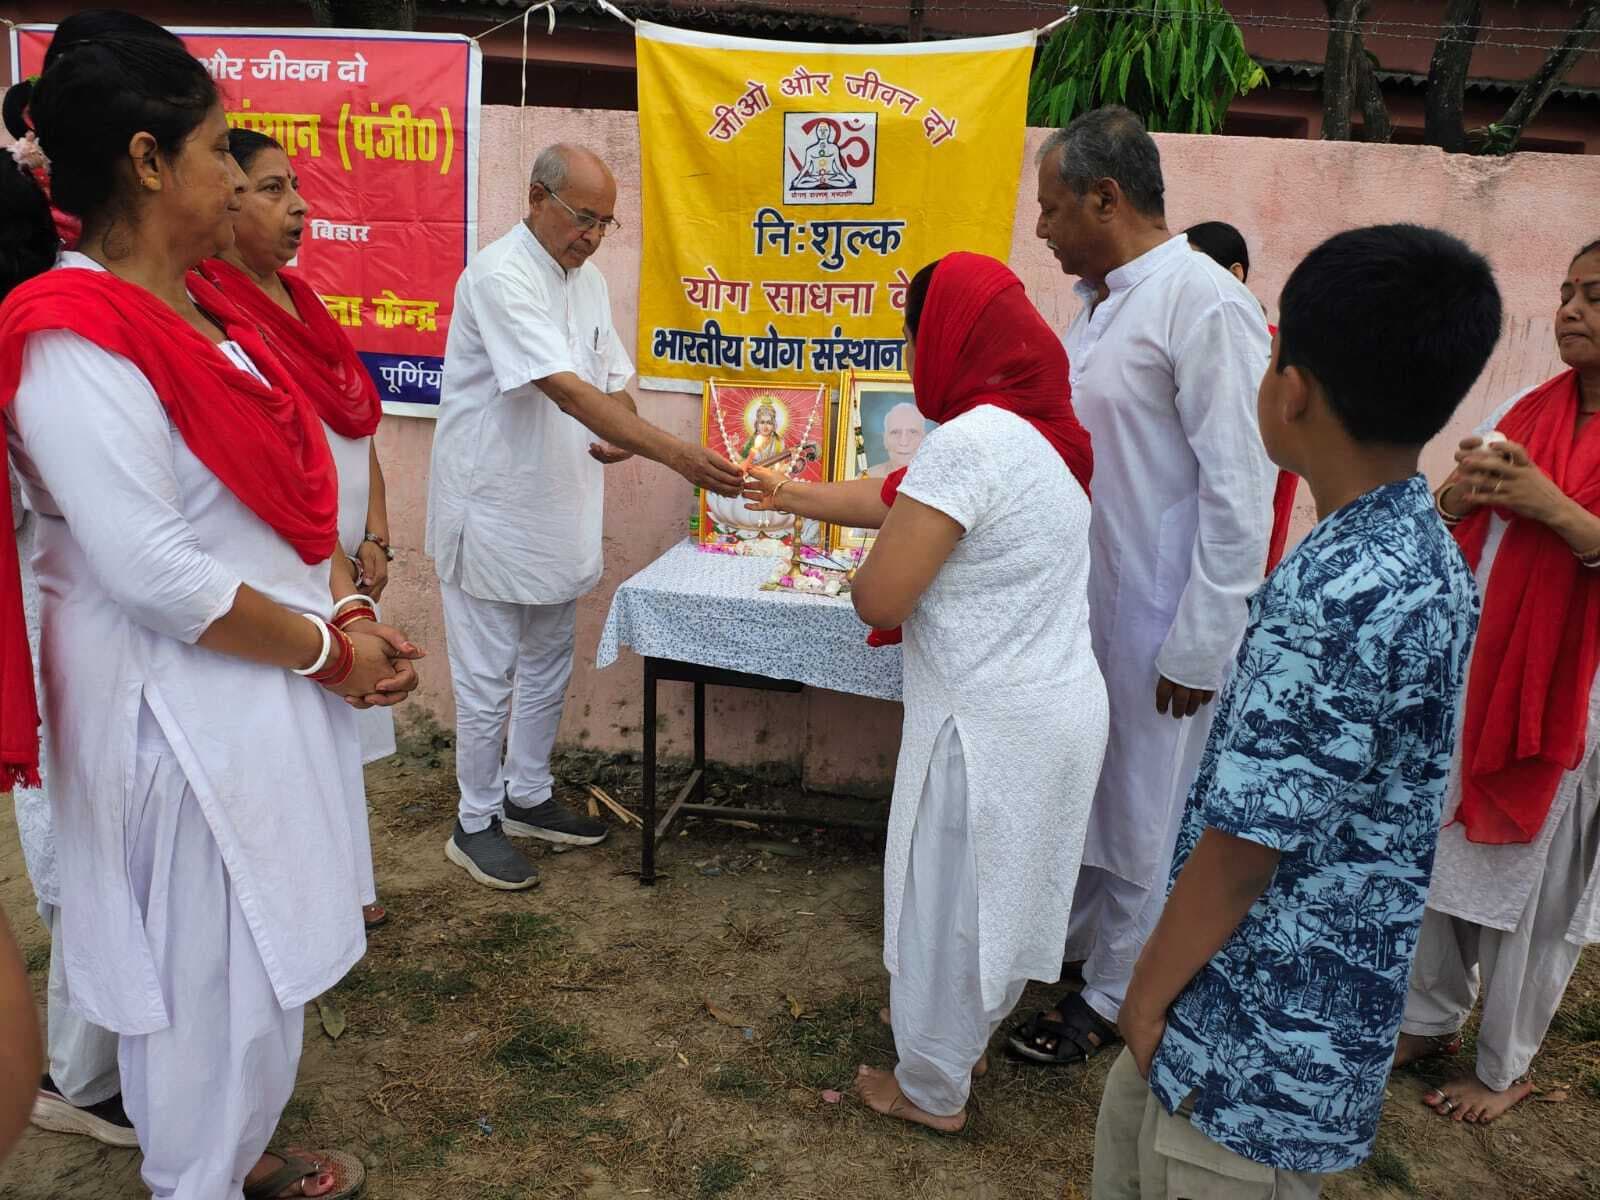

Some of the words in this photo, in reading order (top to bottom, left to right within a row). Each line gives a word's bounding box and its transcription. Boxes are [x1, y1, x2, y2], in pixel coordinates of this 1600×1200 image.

[251, 49, 331, 81] जीवन
[337, 53, 368, 83] दो
[708, 81, 770, 141] जीओ
[781, 67, 831, 96] और
[845, 72, 920, 114] जीवन
[923, 109, 956, 144] दो
[310, 219, 371, 242] बिहार
[372, 289, 440, 332] केन्द्र
[683, 267, 750, 312] योग
[762, 282, 874, 314] साधना
[653, 319, 745, 368] भारतीय
[750, 324, 805, 370] योग
[811, 326, 907, 371] संस्थान
[379, 360, 444, 393] पूर्णिय
